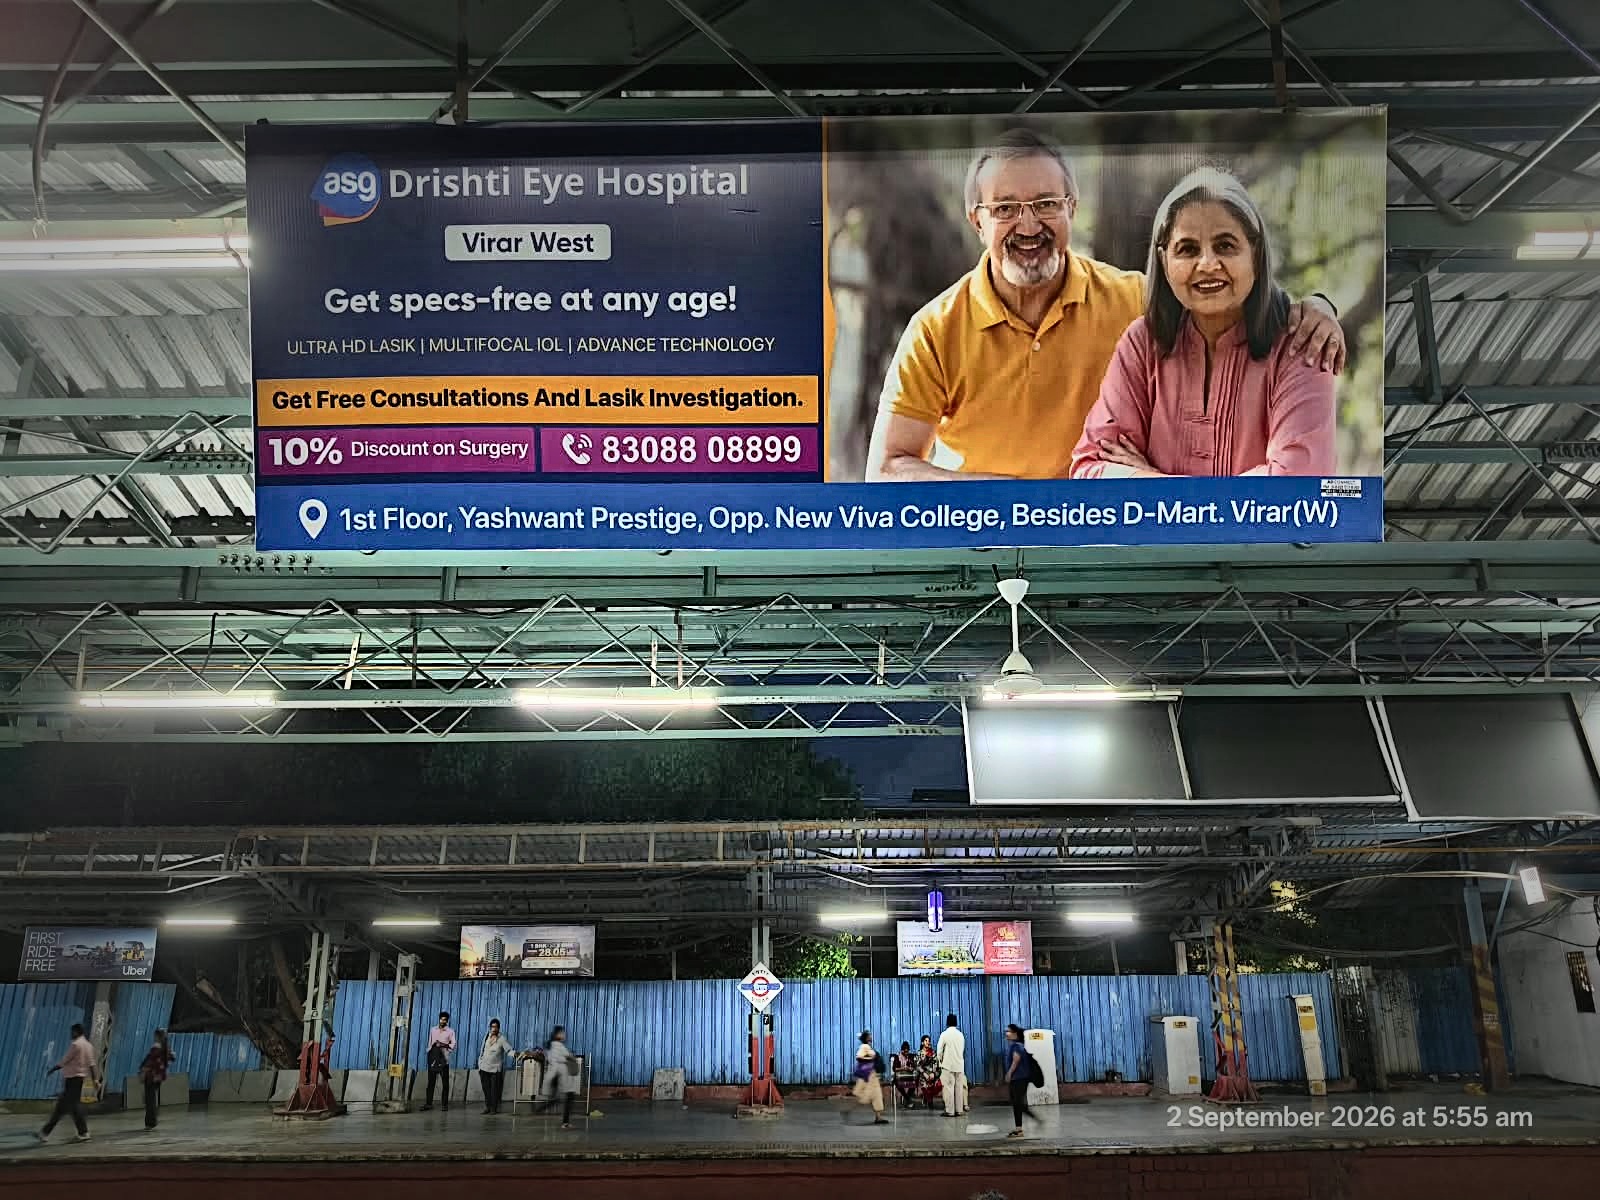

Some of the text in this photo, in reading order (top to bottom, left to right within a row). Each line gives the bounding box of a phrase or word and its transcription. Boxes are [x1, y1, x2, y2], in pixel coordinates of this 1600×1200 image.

[323, 170, 377, 202] asg
[389, 164, 748, 205] Drishti Eye Hospital
[462, 231, 594, 253] Virar West
[324, 285, 737, 319] Get specs-free at any age!
[287, 339, 338, 354] ULTRA
[342, 339, 366, 353] HD
[370, 338, 416, 353] LASIK
[429, 337, 533, 352] MULTIFOCAL
[537, 337, 563, 352] IOL
[577, 337, 656, 352] ADVANCE
[659, 337, 776, 352] TECHNOLOGY
[272, 387, 804, 412] Get Free Consultations And Lasik Investigation.
[268, 437, 529, 466] 10% Discount on Surgery
[602, 435, 801, 463] 83088 08899
[339, 499, 1338, 534] 1st Floor, Yashwant Prestige, Opp. New Viva College, Besides D-Mart. Virar(W)
[29, 932, 64, 945] FIRST
[26, 945, 57, 958] RIDE
[24, 959, 57, 972] FREE
[122, 965, 147, 976] Uber
